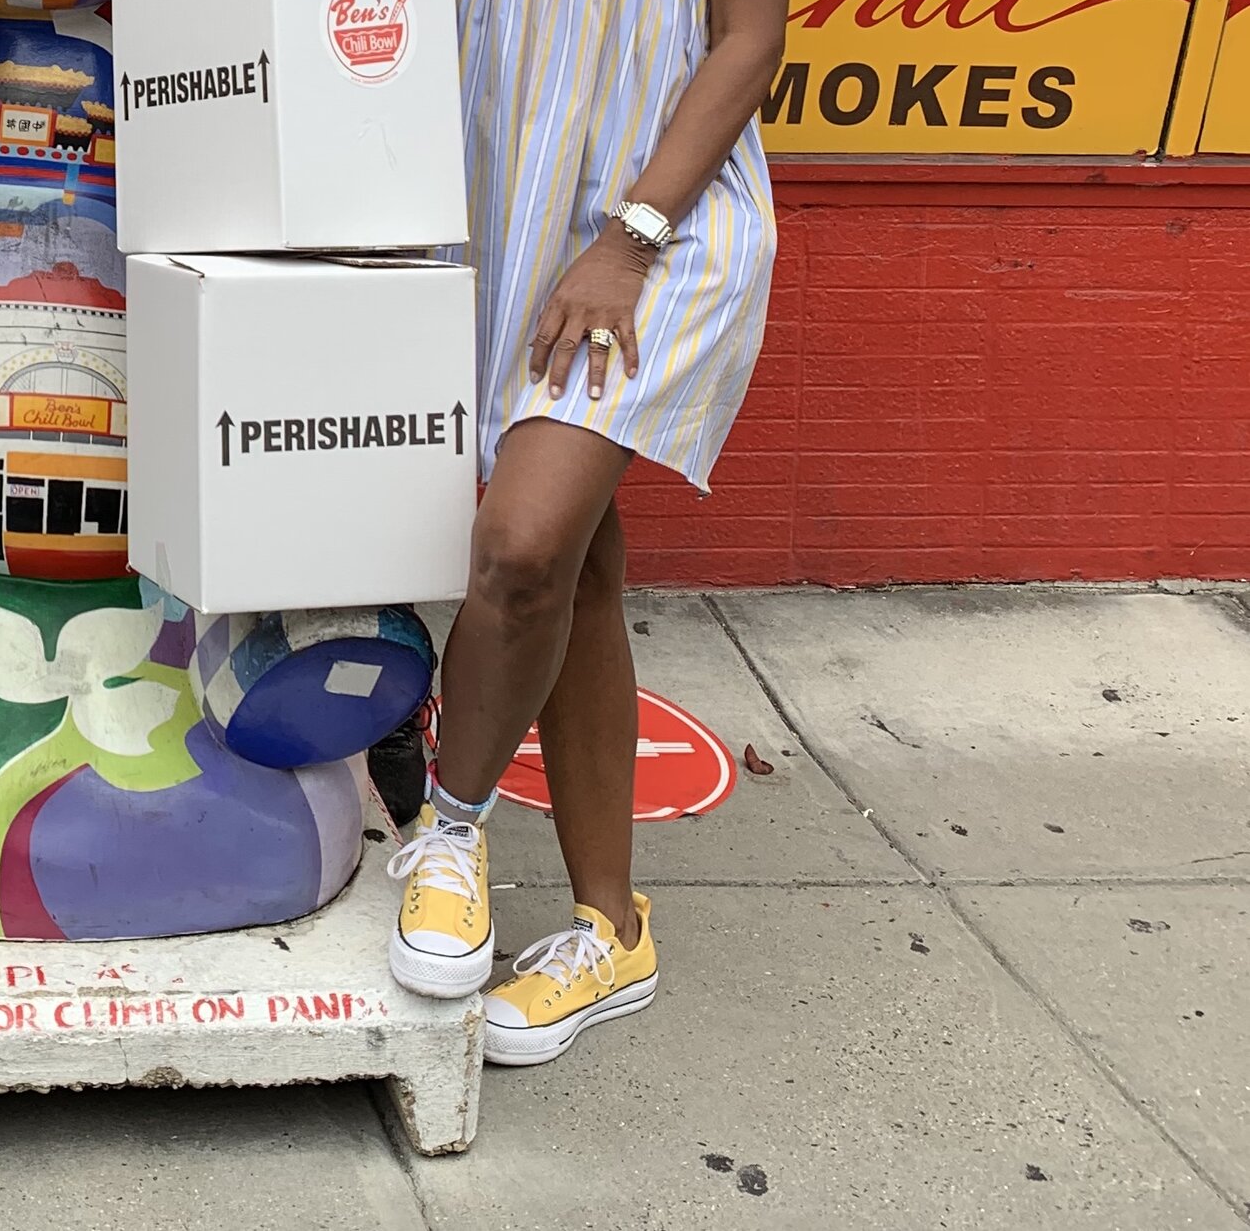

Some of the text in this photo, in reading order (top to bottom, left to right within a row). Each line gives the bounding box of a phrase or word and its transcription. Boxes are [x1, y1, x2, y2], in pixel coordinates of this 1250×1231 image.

[341, 31, 398, 53] Chili Bowl
[133, 61, 256, 109] PERISHABLE
[758, 61, 1076, 130] MOKES
[44, 398, 82, 415] Ben's
[62, 413, 96, 429] Bowl
[240, 412, 446, 454] PERISHABLE
[10, 484, 38, 497] OPEN
[191, 996, 246, 1023] ON
